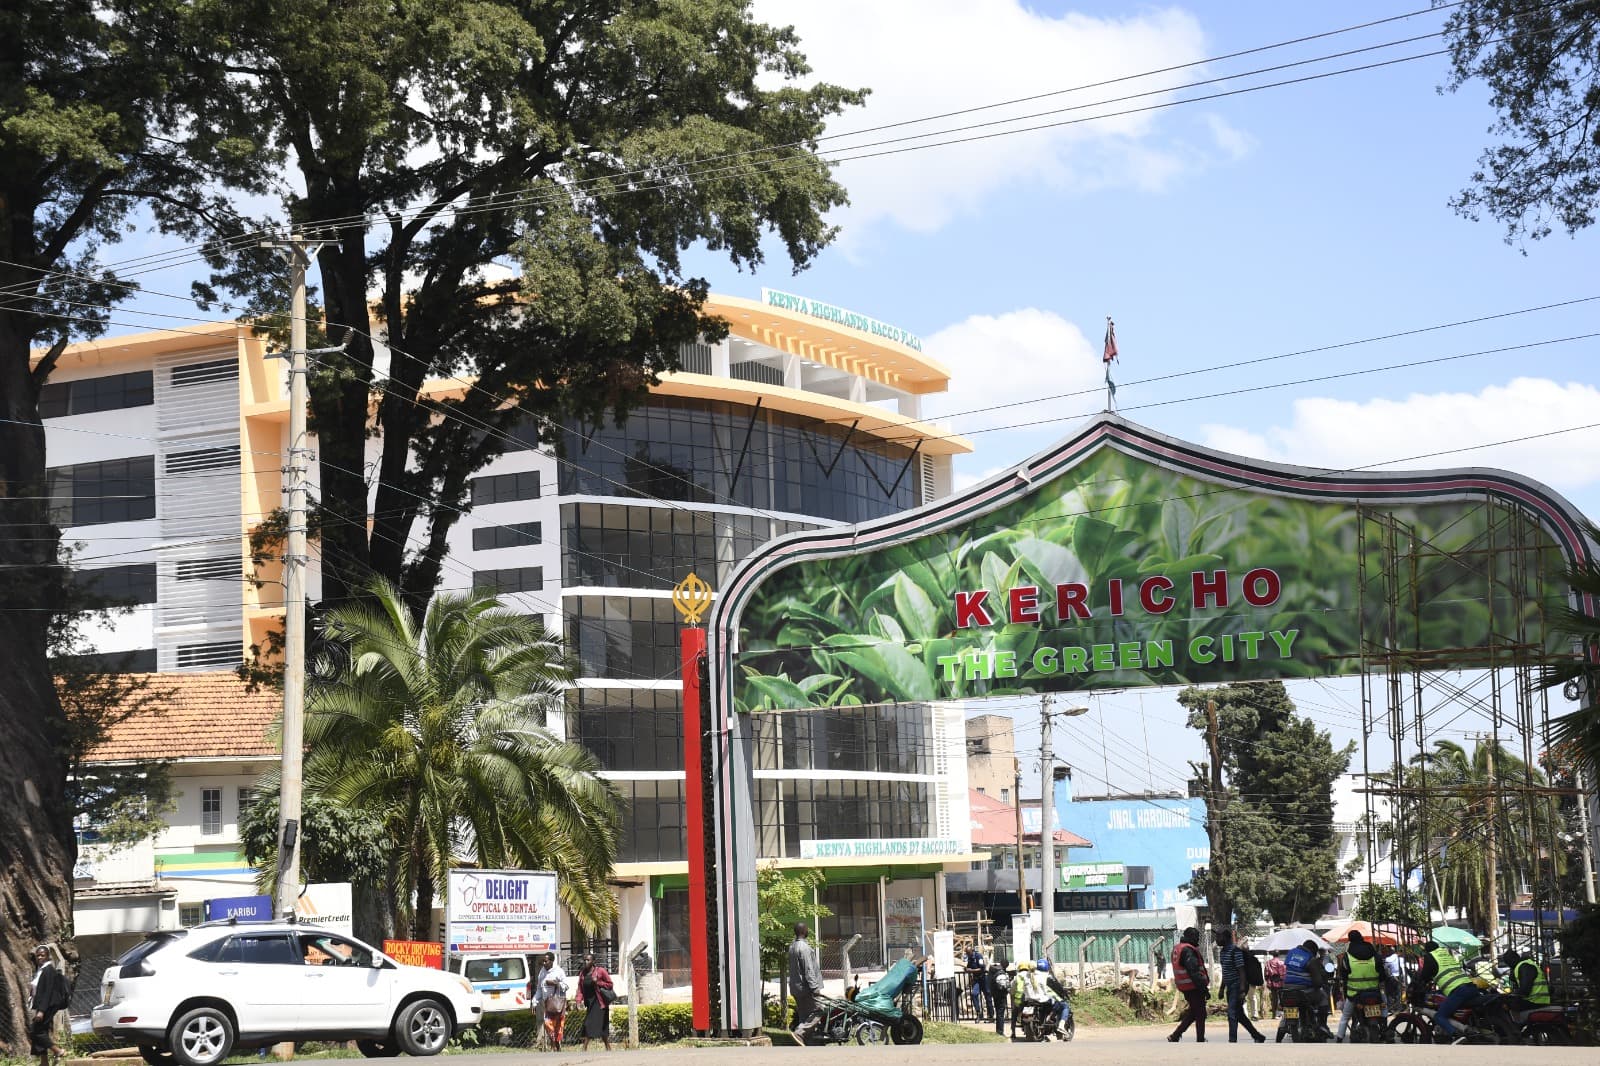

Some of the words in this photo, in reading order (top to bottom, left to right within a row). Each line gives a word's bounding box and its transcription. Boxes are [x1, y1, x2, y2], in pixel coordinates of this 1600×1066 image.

[768, 291, 808, 315] KENYA
[811, 302, 869, 332] HIGHLANDS
[871, 320, 899, 341] SACCO
[954, 567, 1282, 629] KERICHO
[936, 648, 1018, 682] THE
[1032, 639, 1174, 675] GREEN
[1188, 628, 1300, 665] CITY
[1107, 809, 1135, 829] JINAL
[1137, 807, 1191, 829] HARDWARE
[816, 843, 852, 857] KENYA
[854, 841, 907, 856] HIGHLANDS
[921, 841, 943, 855] SACCO
[486, 879, 529, 900] DELIGHT
[472, 902, 501, 913] OPTICAL
[503, 903, 508, 913] &
[510, 903, 538, 914] DENTAL
[1062, 895, 1128, 909] CEMENT
[227, 906, 257, 918] KARIBU
[298, 914, 350, 923] PremierCredit
[385, 942, 410, 955] ROCKY
[411, 943, 441, 956] DRIVING
[394, 954, 426, 967] SCHOOL
